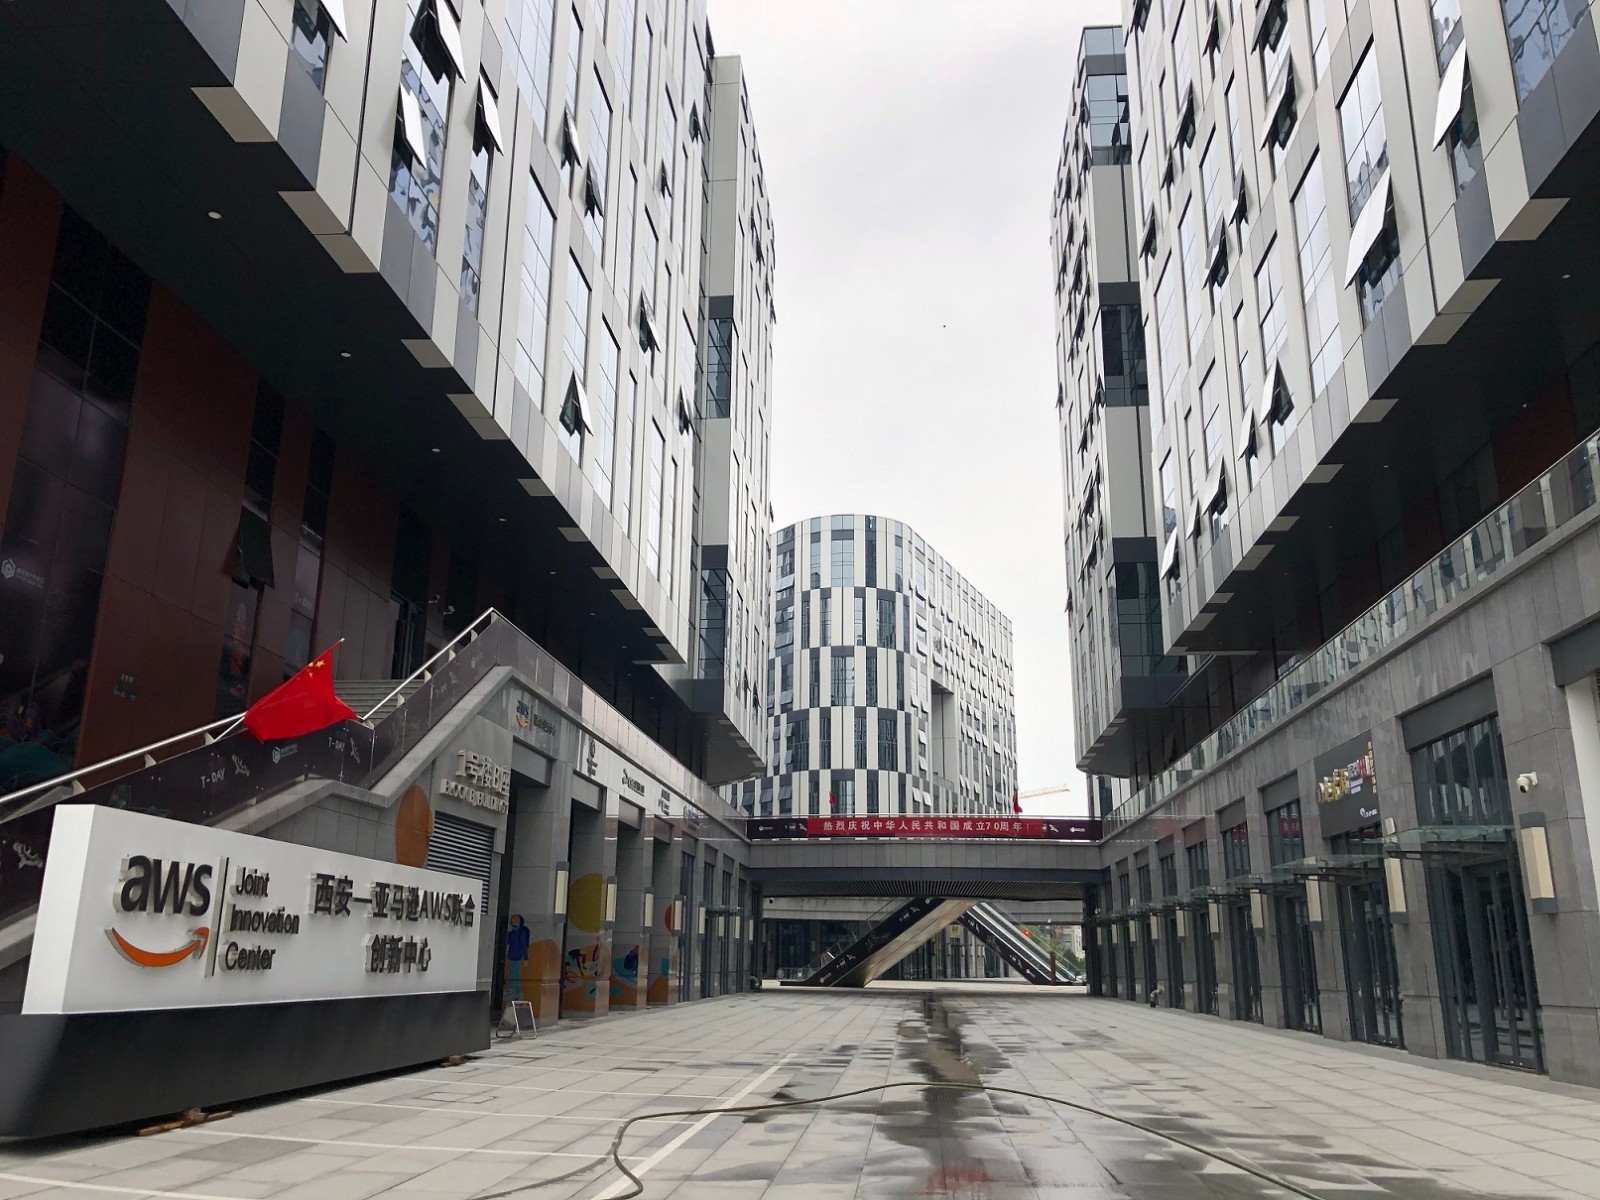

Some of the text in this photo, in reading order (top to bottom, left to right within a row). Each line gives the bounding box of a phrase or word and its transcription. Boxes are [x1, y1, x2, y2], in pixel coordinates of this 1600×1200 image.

[200, 767, 225, 789] T-DAY
[119, 855, 213, 917] aws
[235, 866, 270, 898] Joint
[228, 903, 300, 935] Innovation
[224, 941, 276, 971] Center
[368, 933, 432, 974] 创新中心
